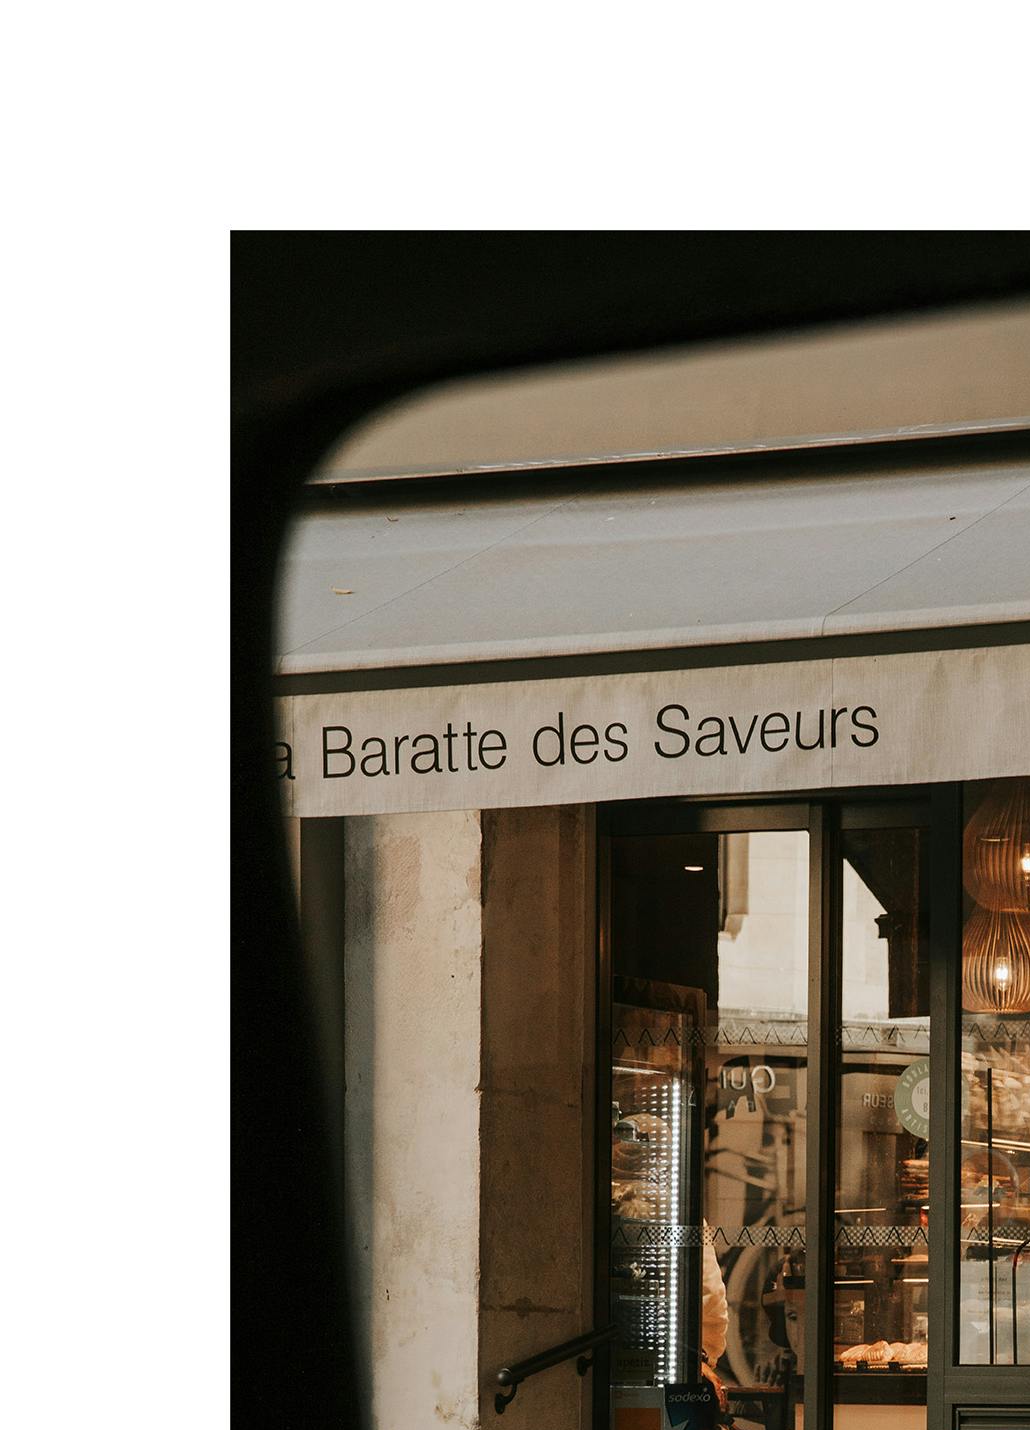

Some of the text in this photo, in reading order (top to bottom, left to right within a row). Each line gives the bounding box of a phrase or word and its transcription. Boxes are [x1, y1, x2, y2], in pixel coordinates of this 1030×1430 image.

[271, 704, 880, 779] a Baratte des Saveurs
[668, 1391, 711, 1402] sodexo
